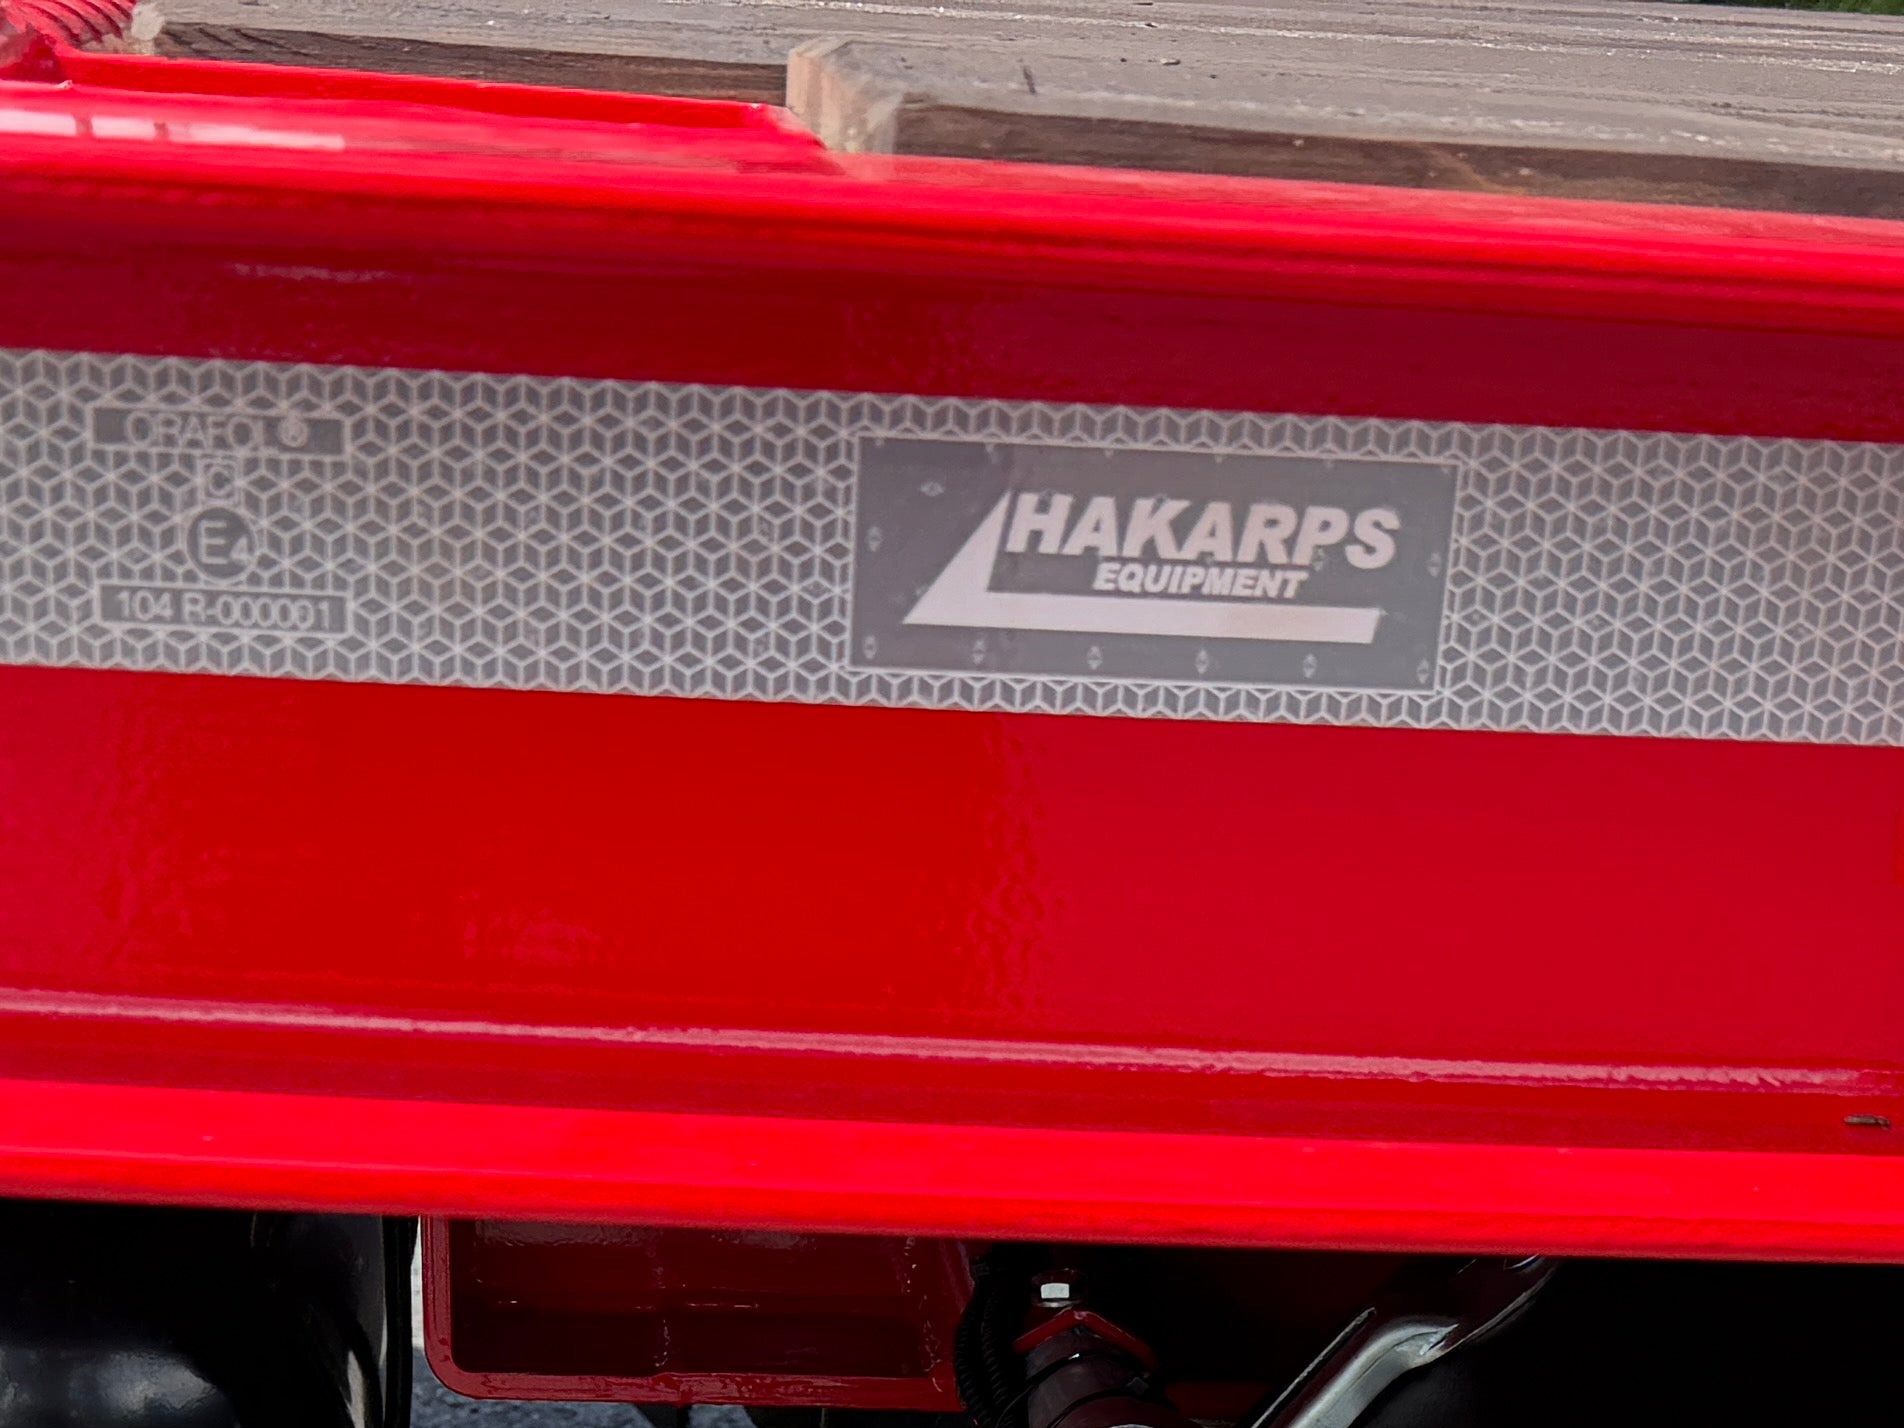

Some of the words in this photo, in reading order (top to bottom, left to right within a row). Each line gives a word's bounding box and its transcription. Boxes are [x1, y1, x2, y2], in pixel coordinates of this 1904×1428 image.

[1005, 491, 1401, 570] HAKARPS
[1093, 561, 1309, 599] EQUIPMENT
[116, 590, 173, 622] 104
